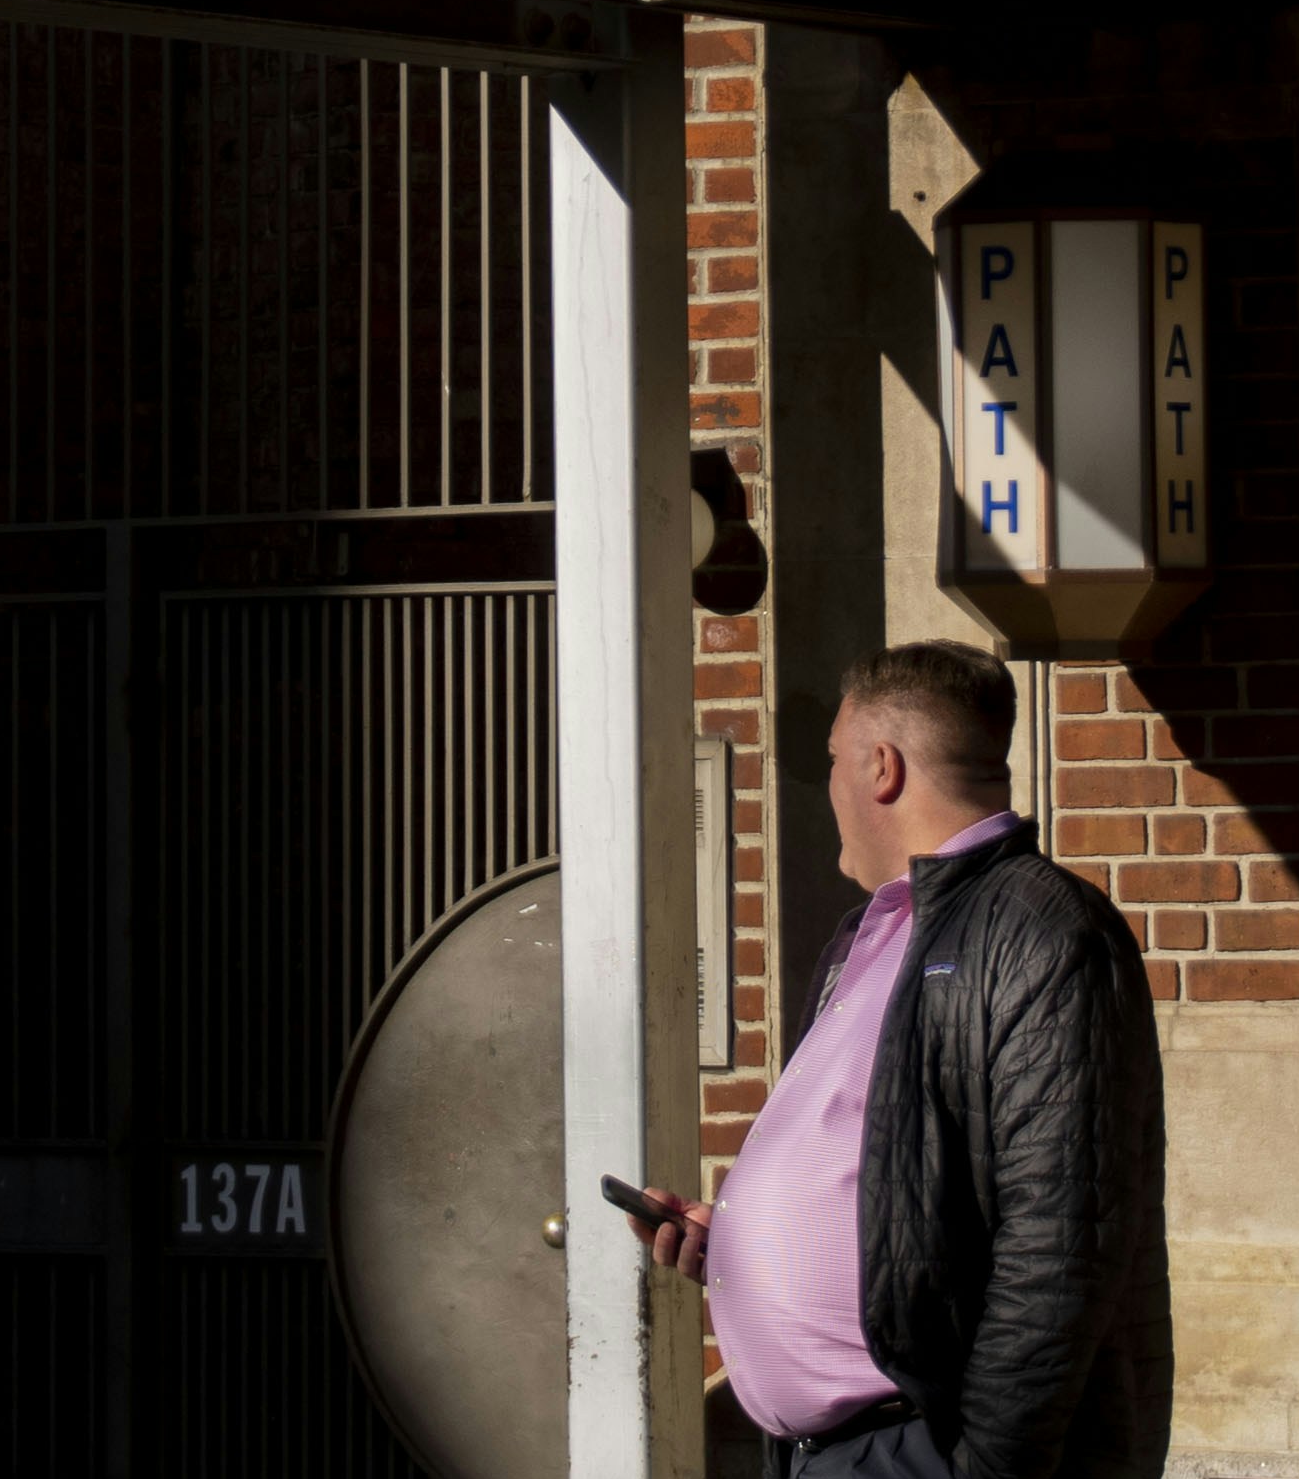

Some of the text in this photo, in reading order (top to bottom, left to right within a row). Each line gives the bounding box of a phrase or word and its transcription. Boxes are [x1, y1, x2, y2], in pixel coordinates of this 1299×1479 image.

[979, 245, 1019, 534] PATH
[1164, 247, 1195, 534] PATH
[180, 1162, 306, 1234] 137A
